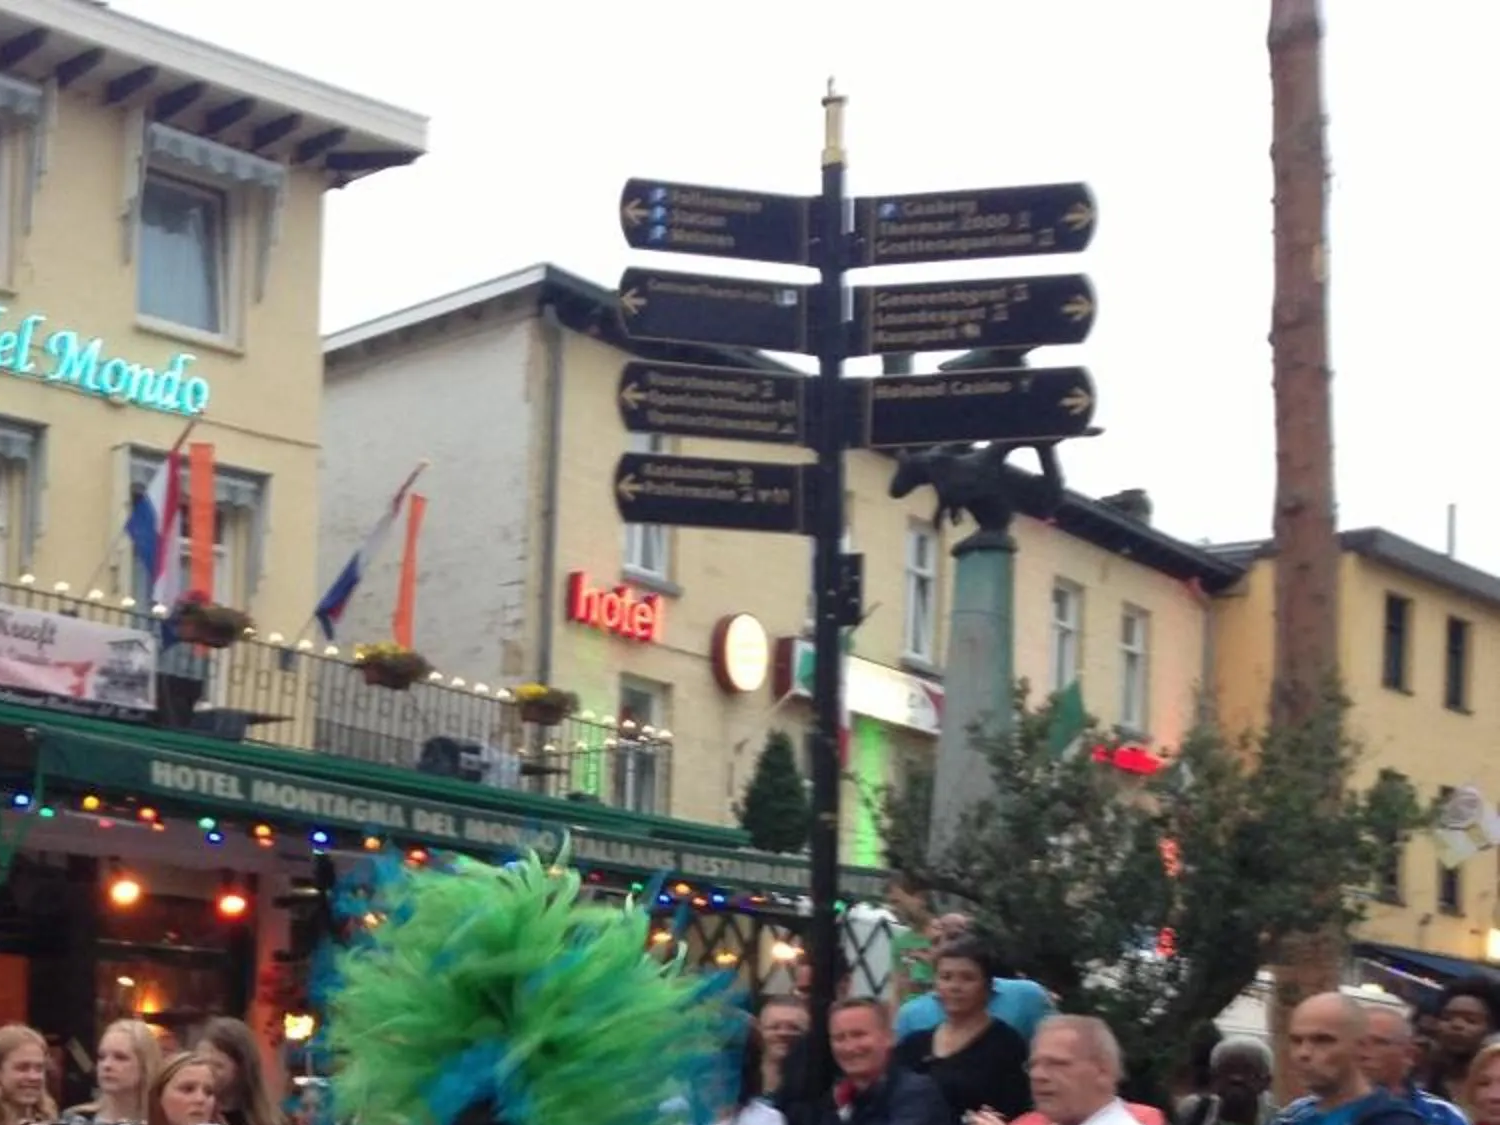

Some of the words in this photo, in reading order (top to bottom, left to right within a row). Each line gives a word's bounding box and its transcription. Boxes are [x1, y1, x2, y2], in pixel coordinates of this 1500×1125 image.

[46, 331, 209, 415] Mondo
[568, 571, 664, 642] hotel
[152, 760, 244, 799] HOTEL
[252, 779, 408, 829] MONTAGNA
[412, 809, 458, 838] DEL
